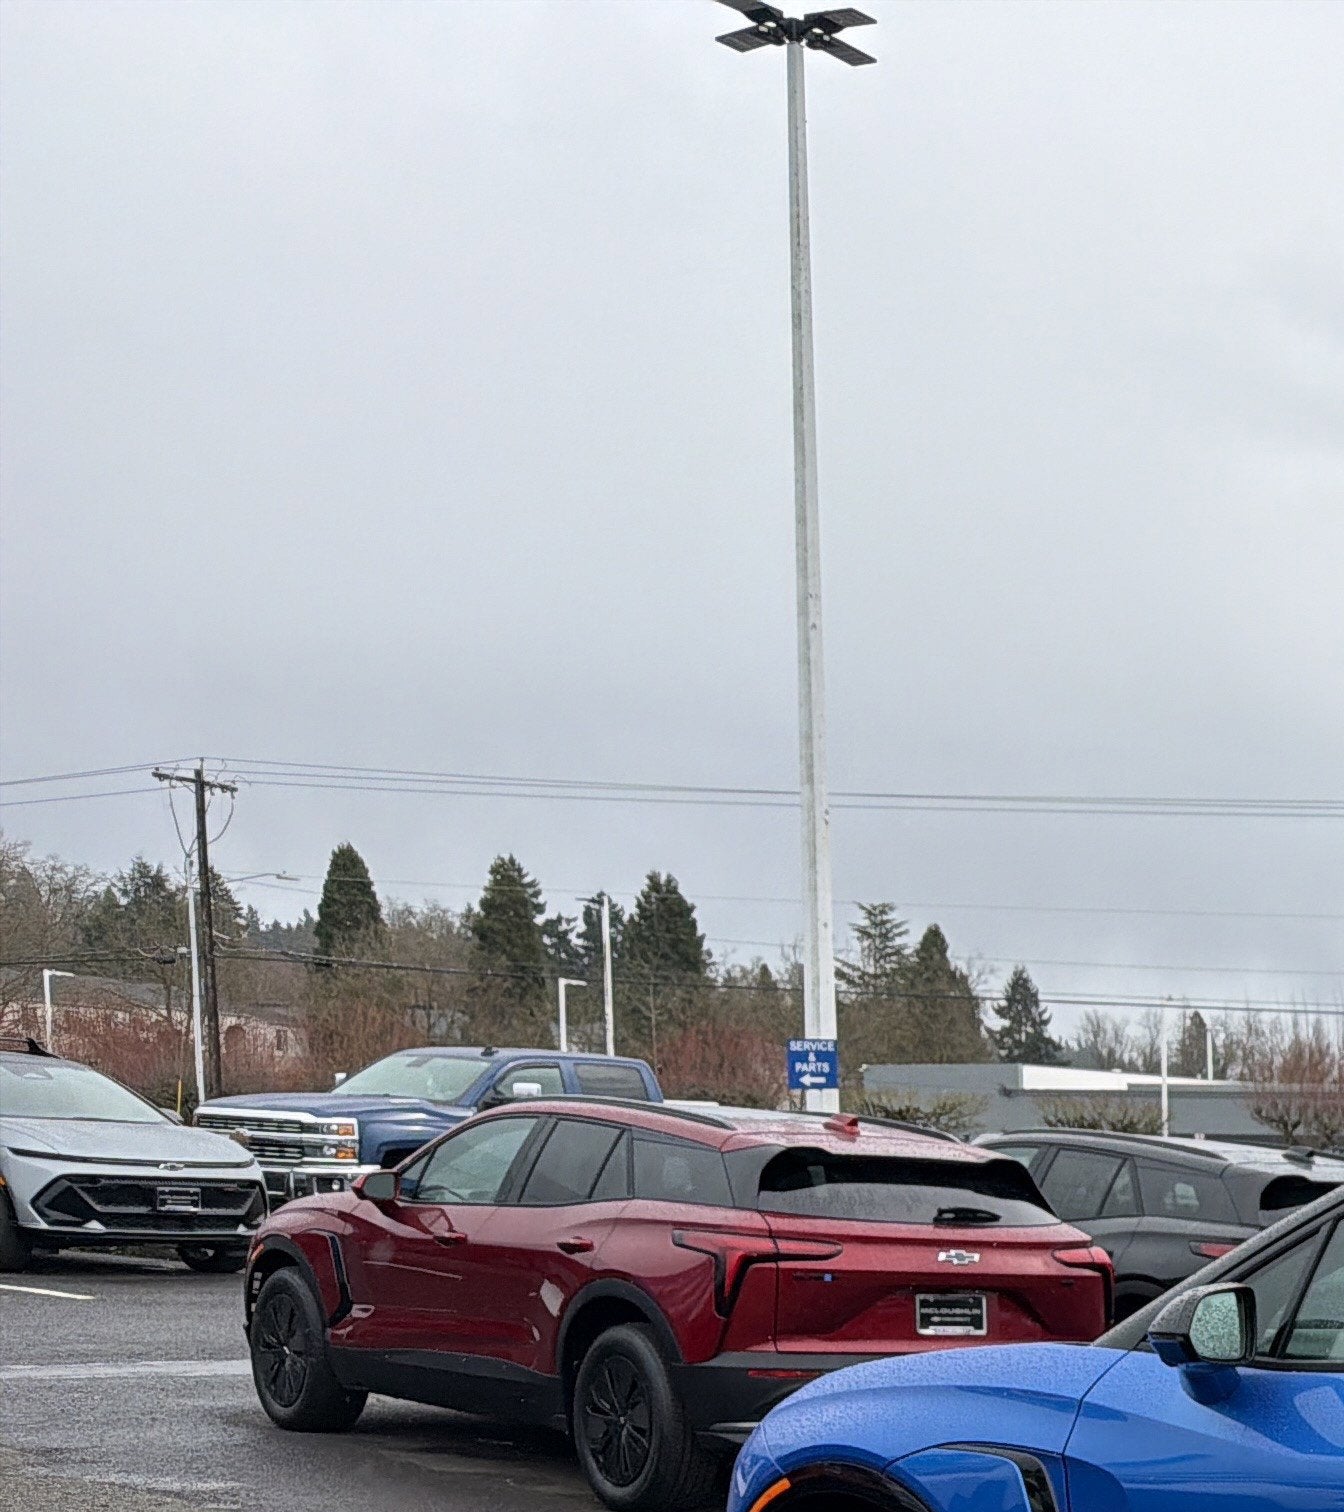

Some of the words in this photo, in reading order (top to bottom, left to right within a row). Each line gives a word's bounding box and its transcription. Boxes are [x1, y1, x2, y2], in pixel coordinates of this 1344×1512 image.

[790, 1040, 835, 1051] SERVICE
[808, 1052, 816, 1061] &
[795, 1062, 830, 1073] PARTS
